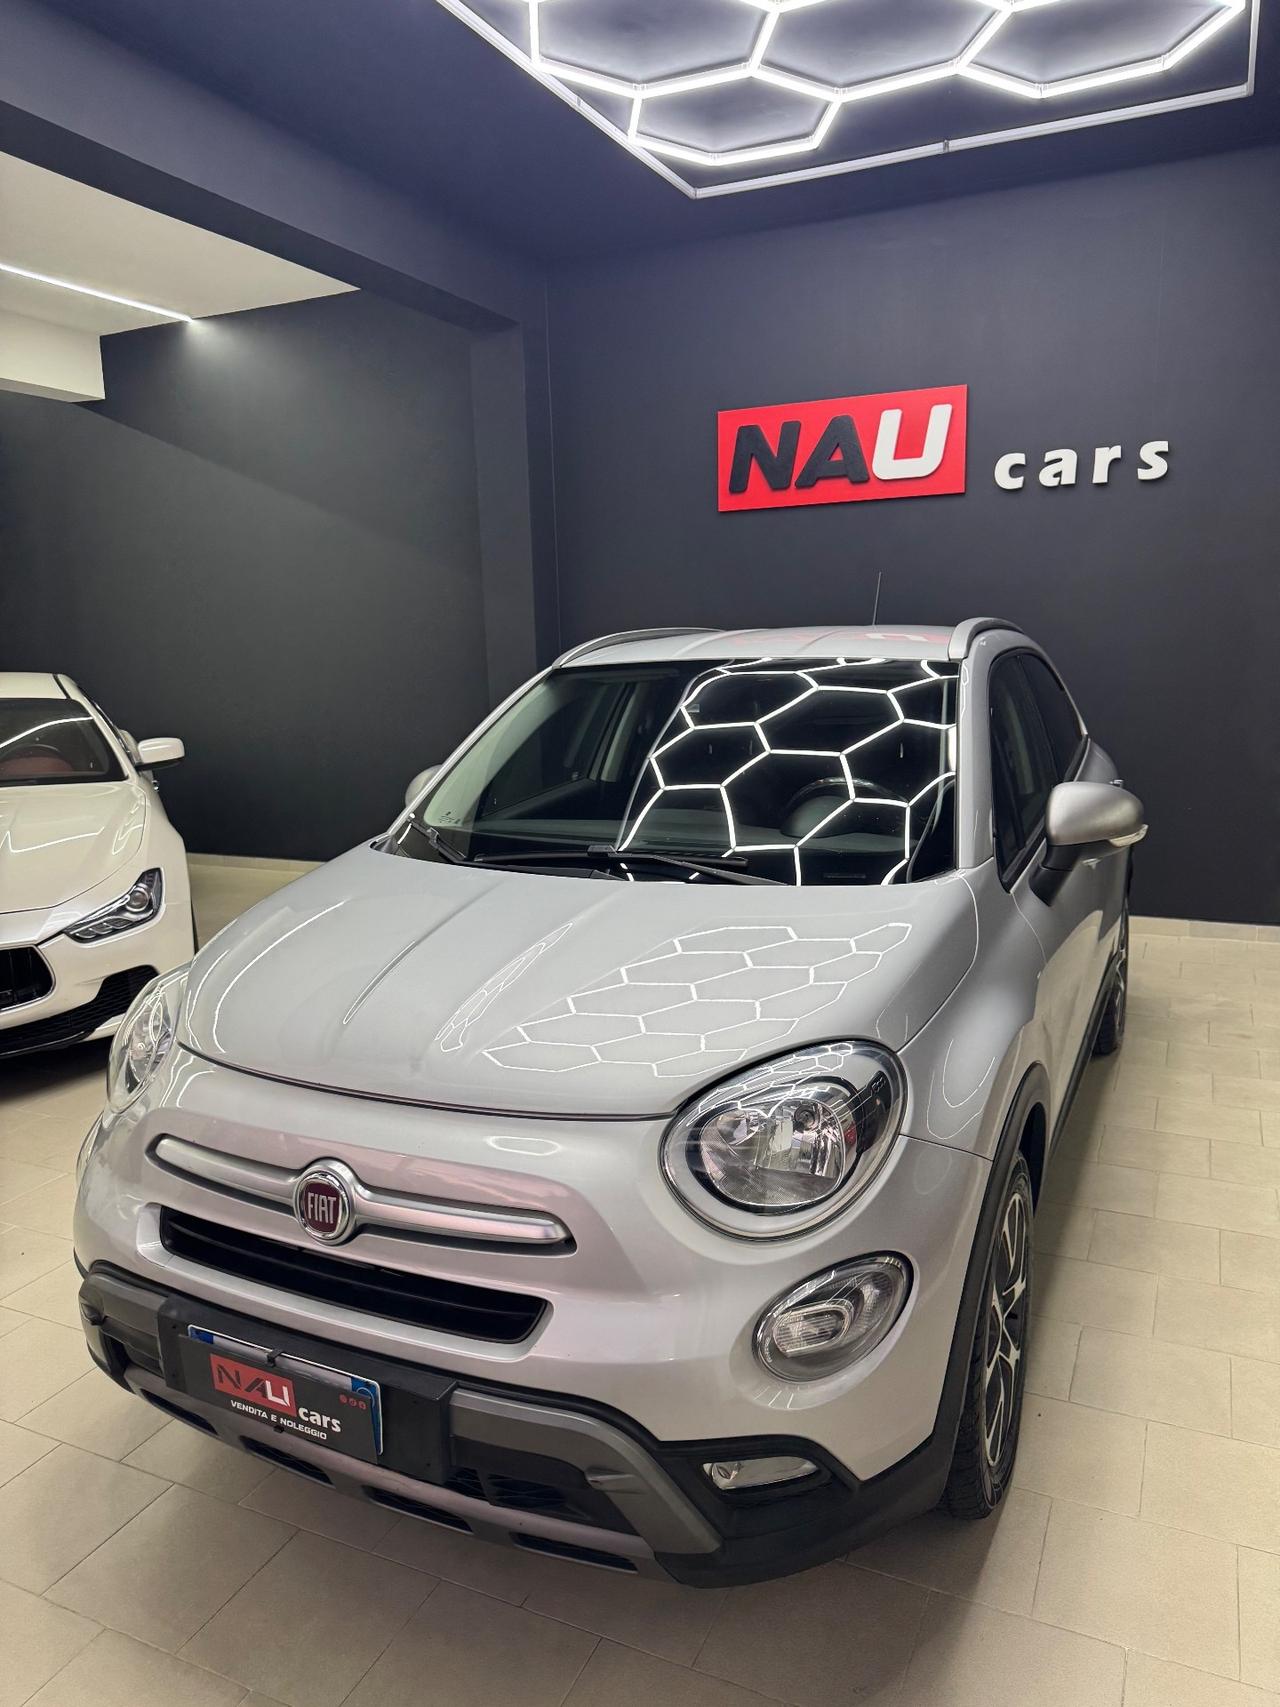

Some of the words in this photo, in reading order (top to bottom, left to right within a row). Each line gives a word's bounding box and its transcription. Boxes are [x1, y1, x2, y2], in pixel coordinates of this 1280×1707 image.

[729, 404, 952, 493] NAU
[994, 440, 1169, 490] cars
[307, 1192, 337, 1224] FIAT
[216, 1364, 291, 1407] NAU
[298, 1407, 342, 1433] cars
[230, 1399, 268, 1419] VENDITA
[270, 1414, 278, 1423] E
[279, 1417, 327, 1440] NOLEGGIO
